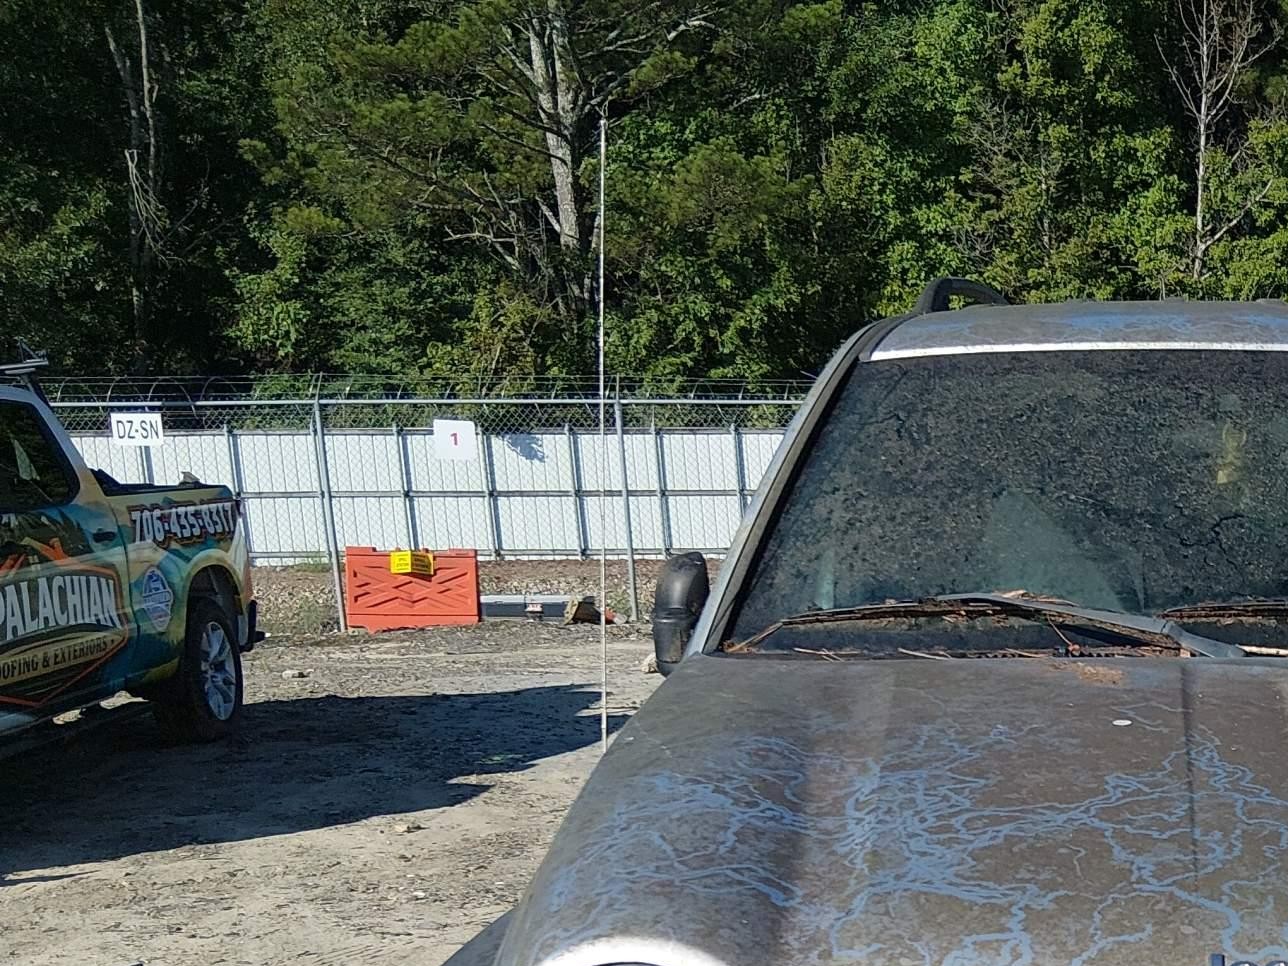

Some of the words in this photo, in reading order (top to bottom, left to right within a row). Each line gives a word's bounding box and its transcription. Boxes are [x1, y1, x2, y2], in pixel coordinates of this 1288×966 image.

[116, 420, 159, 439] DZ-SN
[450, 432, 458, 446] 1
[0, 655, 39, 680] OFING
[42, 652, 50, 668] &
